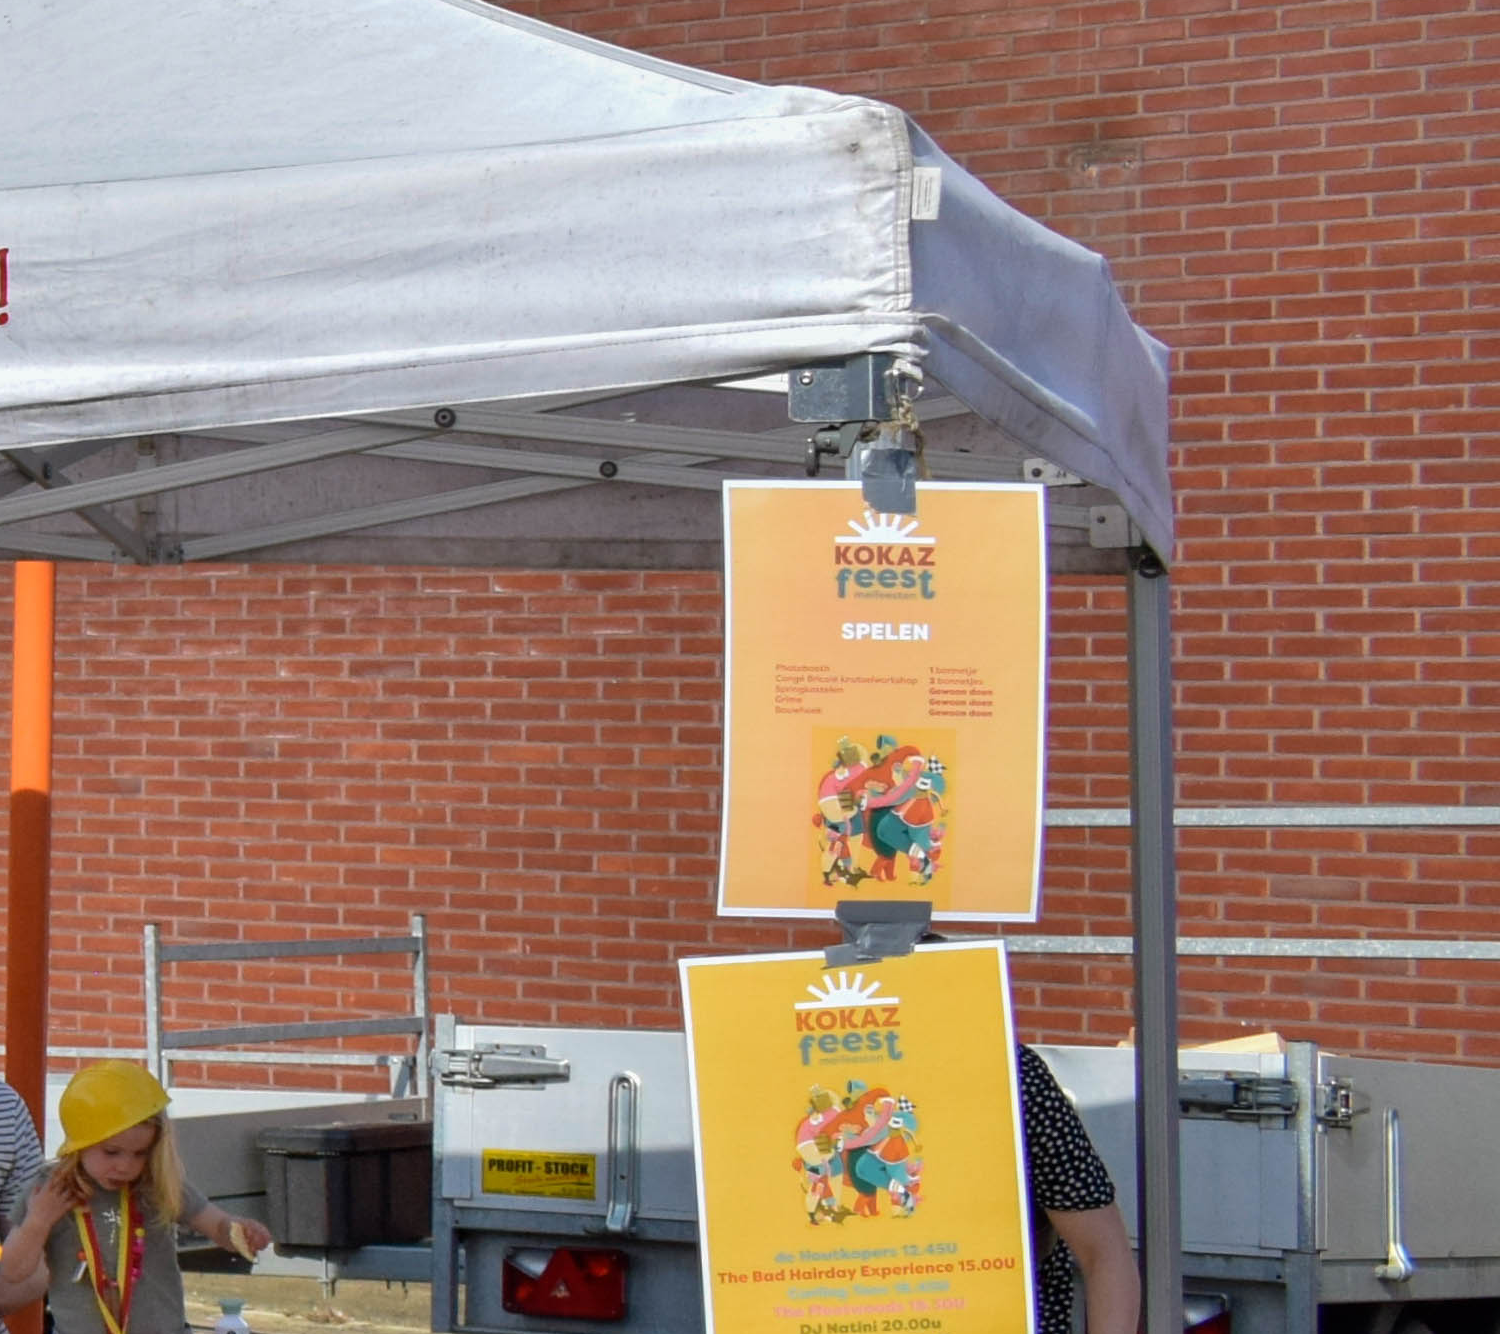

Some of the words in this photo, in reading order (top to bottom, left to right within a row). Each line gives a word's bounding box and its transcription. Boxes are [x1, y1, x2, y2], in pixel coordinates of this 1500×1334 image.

[834, 546, 936, 566] KOKAZ
[836, 568, 936, 599] feest
[841, 622, 930, 641] SPELEN
[795, 1007, 901, 1032] KOKAZ
[798, 1031, 903, 1066] feest
[488, 1158, 533, 1174] PROFIT
[544, 1161, 589, 1175] STOCK
[717, 1272, 749, 1284] The
[752, 1269, 785, 1282] Bad
[790, 1267, 857, 1281] Hairday
[861, 1262, 954, 1279] Experience
[958, 1257, 1016, 1272] 15.00U
[827, 1320, 877, 1334] Natini
[881, 1318, 942, 1332] 20.00u
